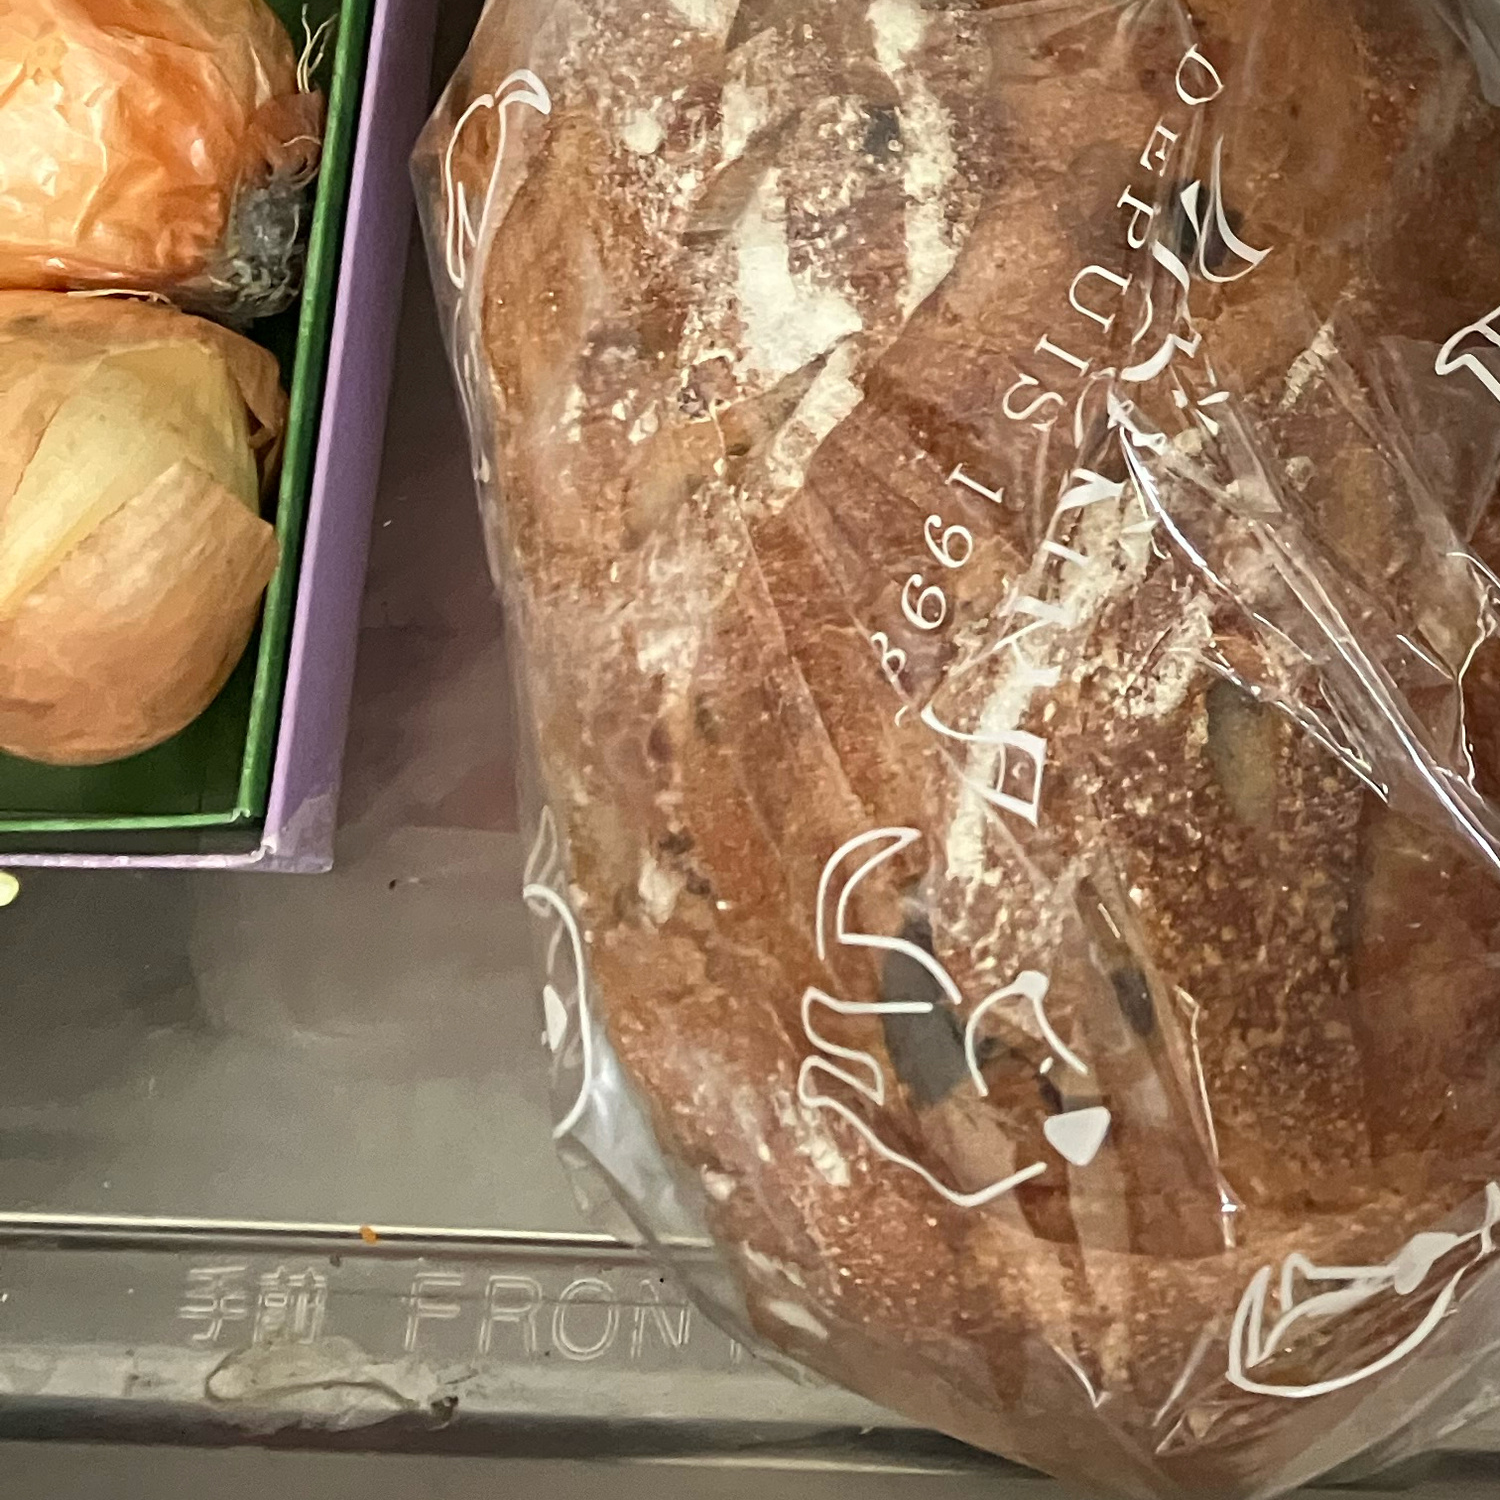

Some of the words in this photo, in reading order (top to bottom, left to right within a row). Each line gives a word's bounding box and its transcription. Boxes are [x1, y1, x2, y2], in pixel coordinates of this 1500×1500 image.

[1003, 45, 1224, 431] DEPUIS
[179, 1264, 326, 1346] 手前
[402, 1271, 745, 1364] FRON
